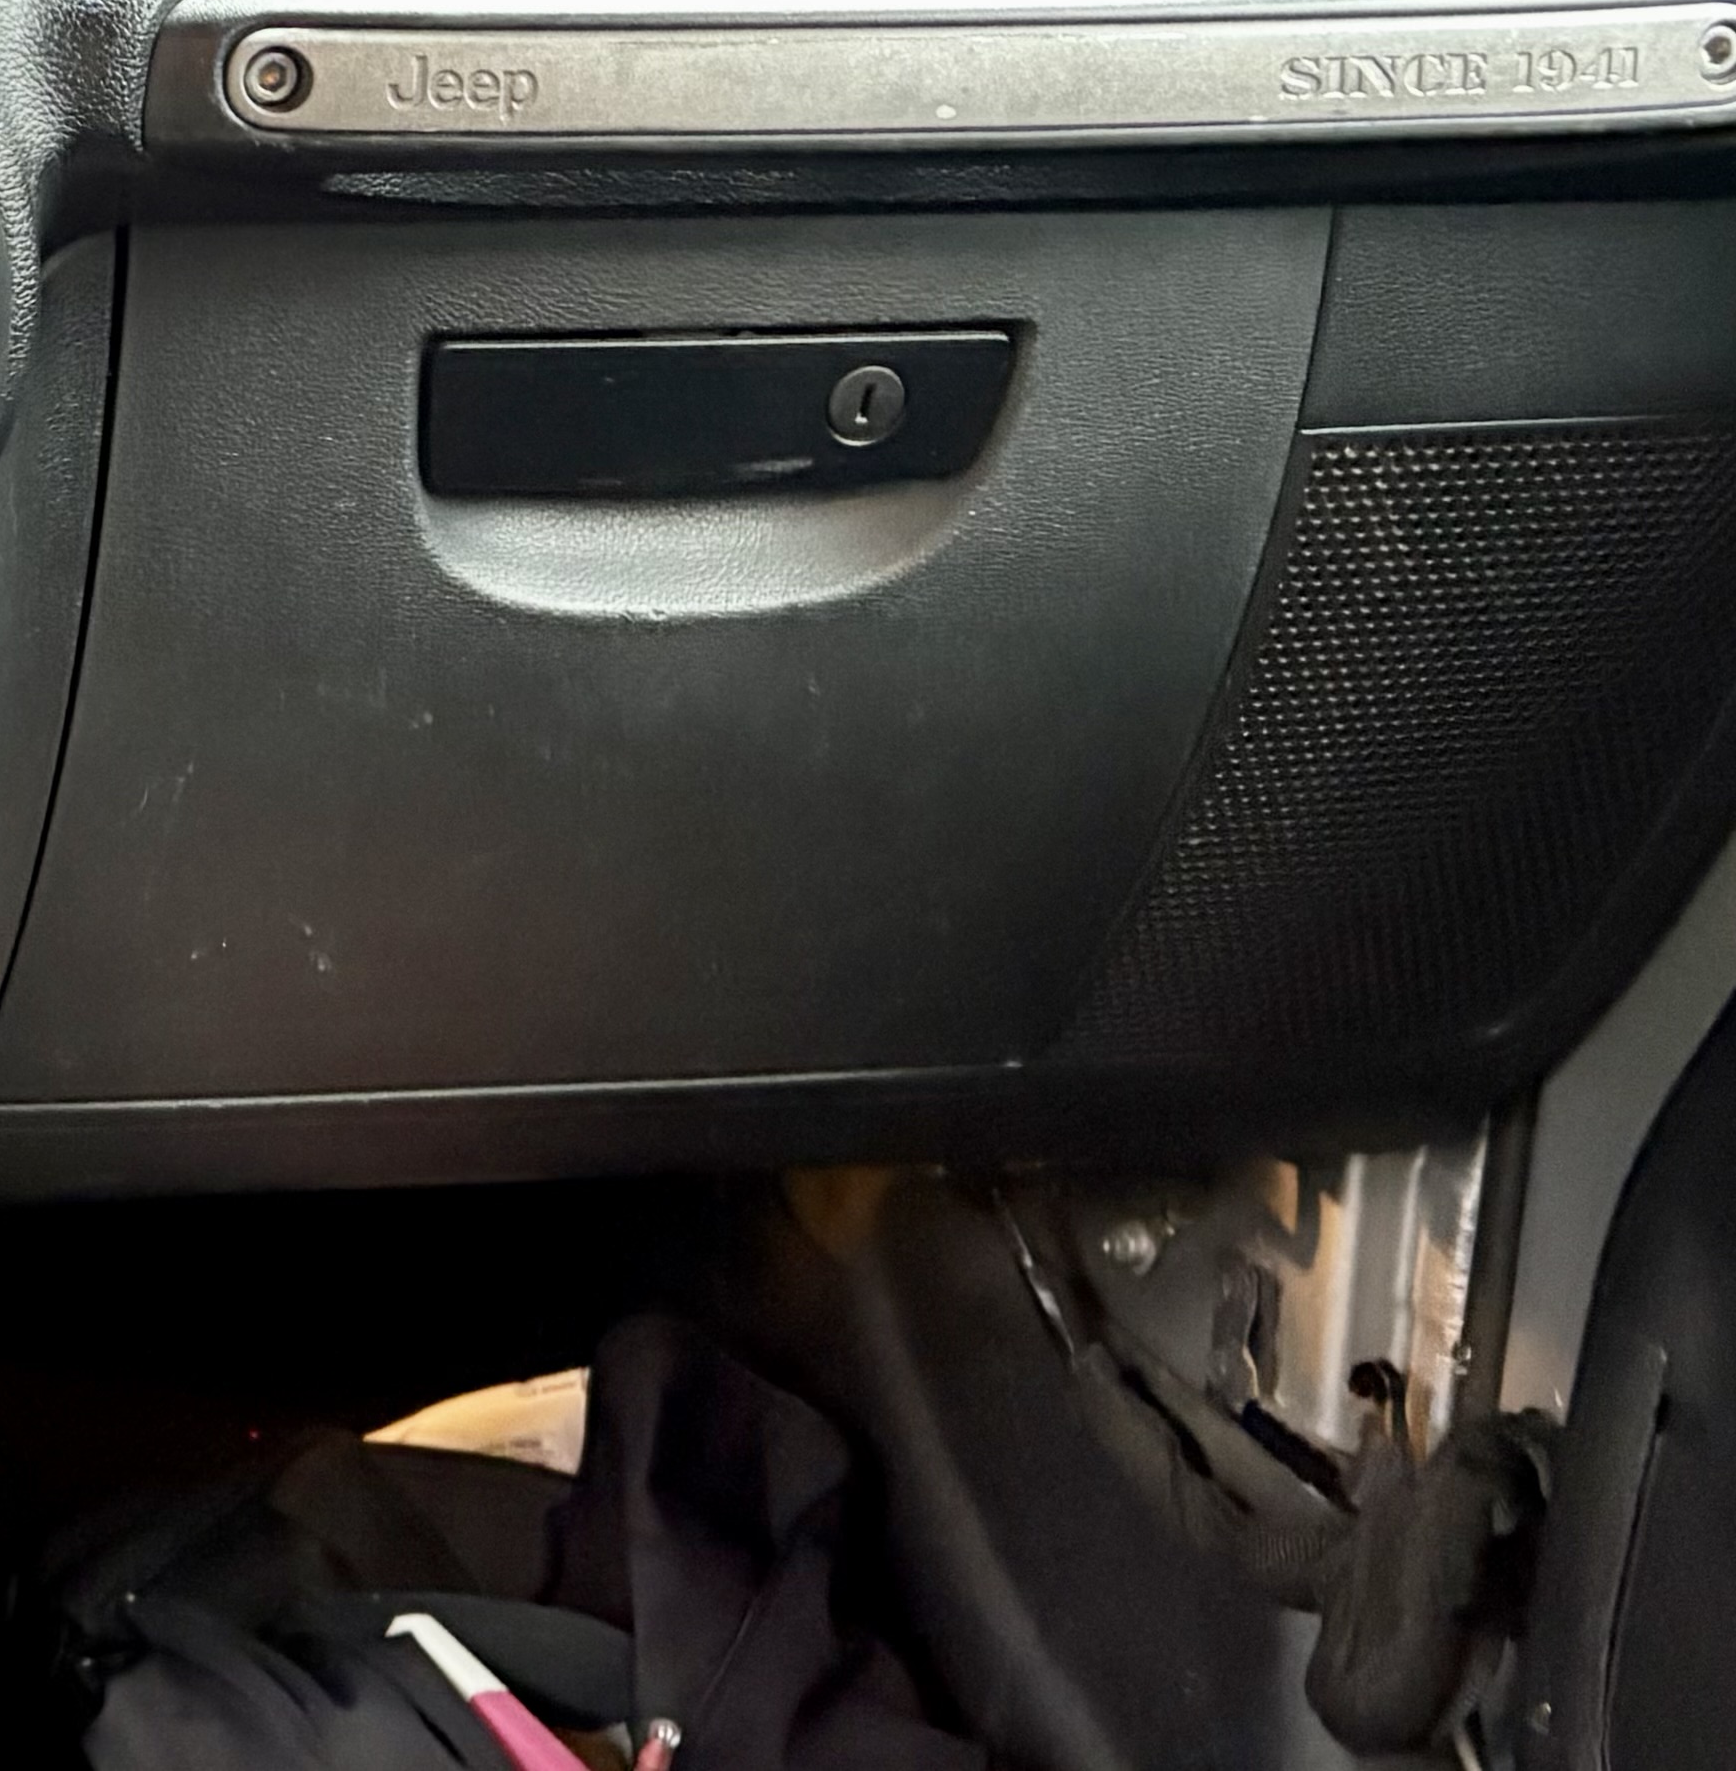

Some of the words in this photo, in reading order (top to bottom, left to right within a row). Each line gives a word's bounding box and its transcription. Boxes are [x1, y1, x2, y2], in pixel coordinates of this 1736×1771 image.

[386, 54, 539, 121] Jeep
[1278, 51, 1488, 101] SINCE
[1511, 45, 1641, 94] 1941
